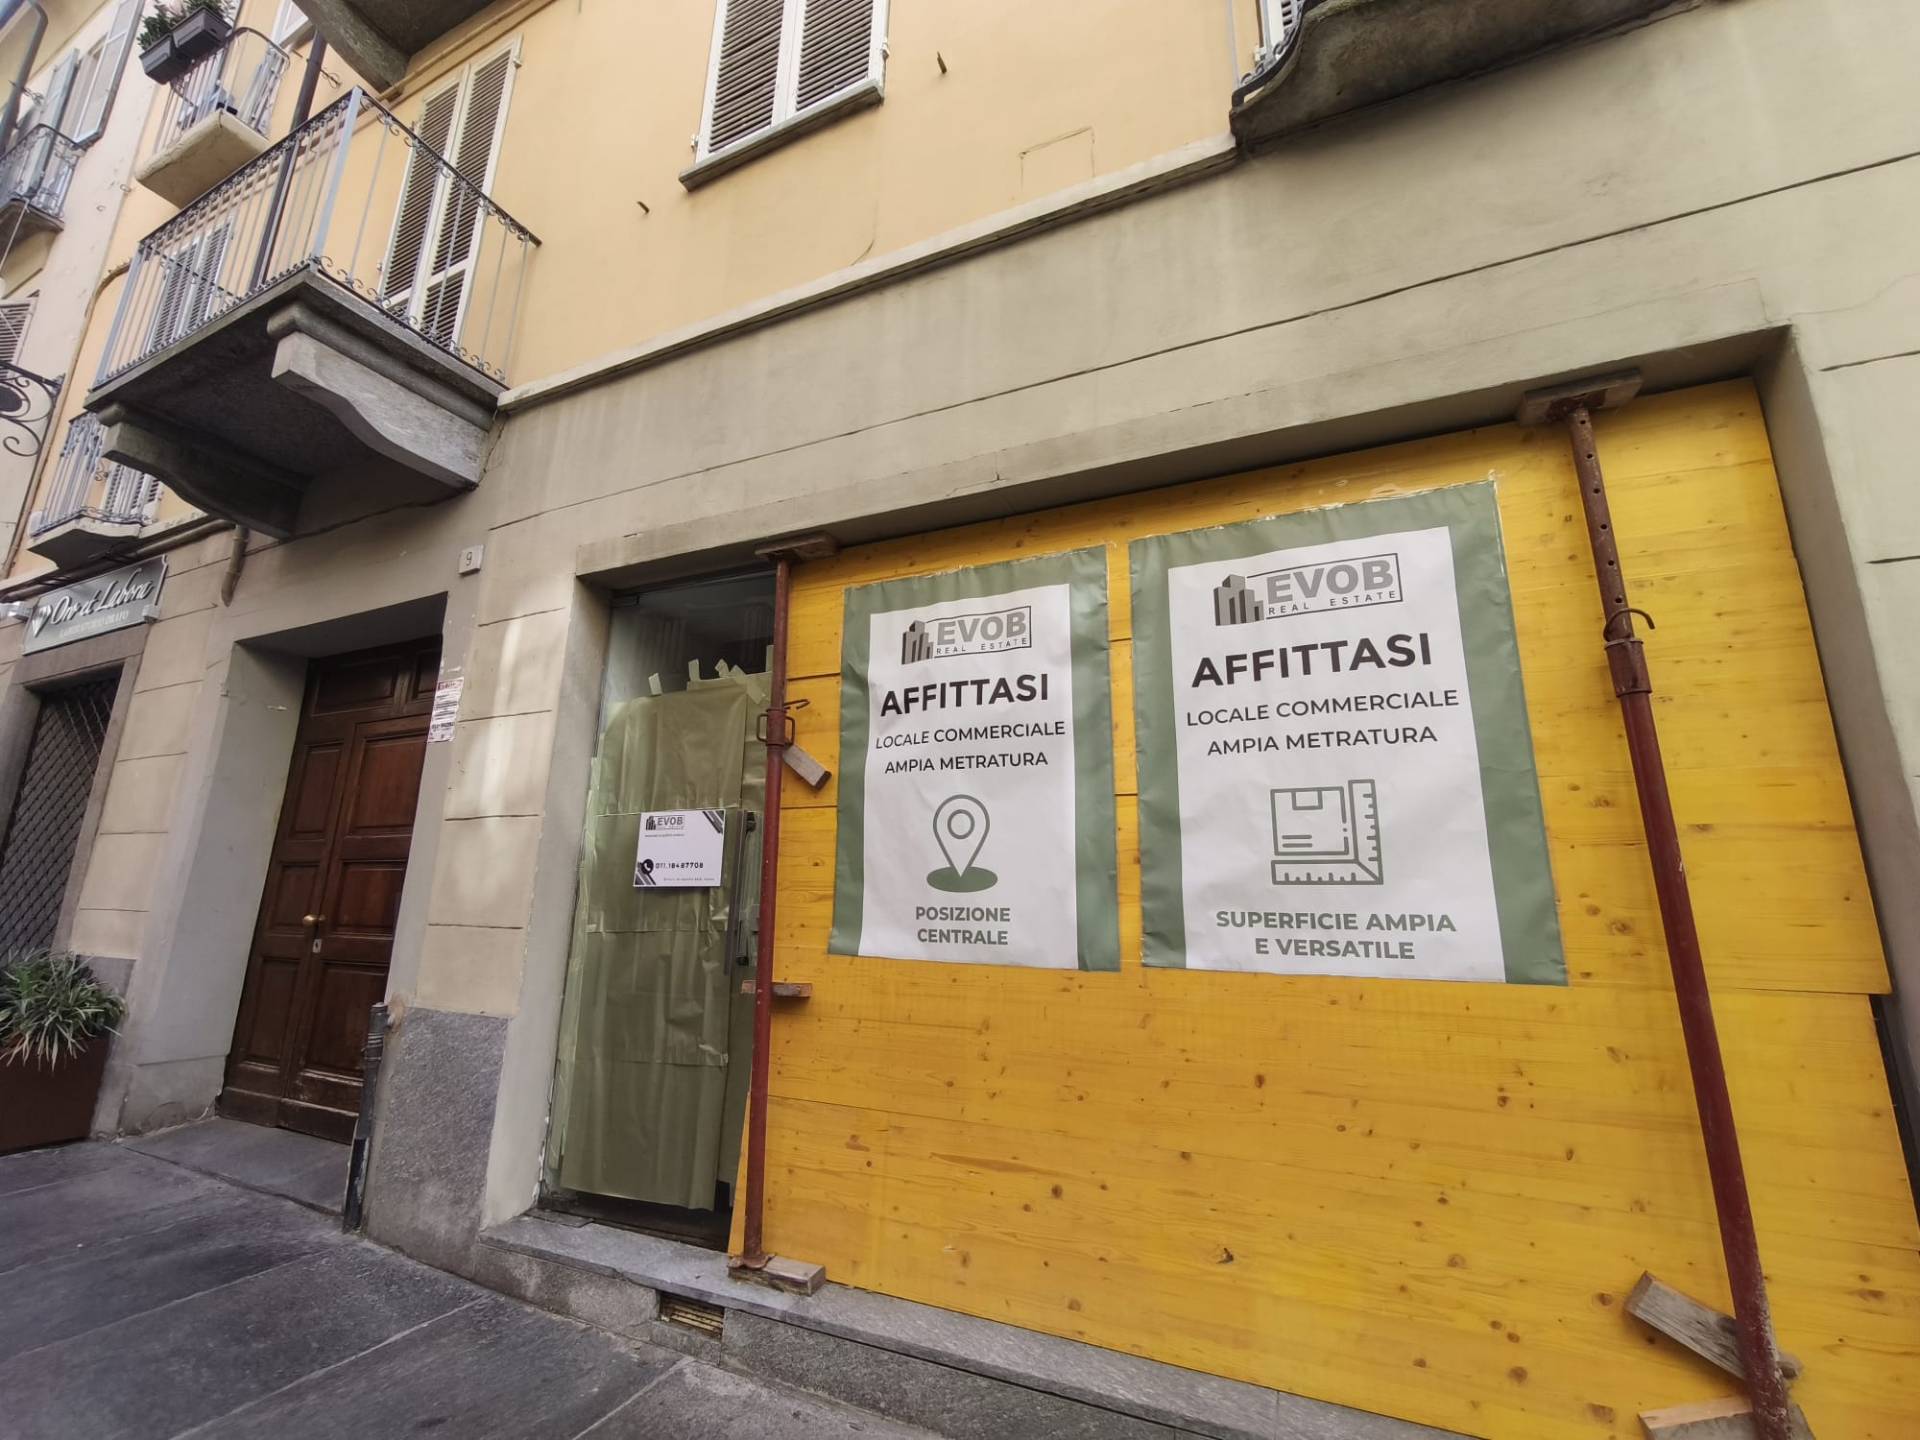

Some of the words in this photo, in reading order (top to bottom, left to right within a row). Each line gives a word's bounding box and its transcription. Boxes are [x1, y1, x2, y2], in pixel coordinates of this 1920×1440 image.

[465, 552, 472, 566] 9
[1266, 559, 1393, 605] EVOB
[1267, 603, 1309, 616] REAL
[1329, 590, 1397, 606] ESTATE
[937, 612, 1026, 645] EVOB
[936, 646, 967, 656] REAL
[980, 637, 1028, 651] ESTATE
[1191, 633, 1433, 688] AFFITTASI
[880, 673, 1049, 717] AFFITTASI
[1186, 704, 1270, 727] LOCALE
[1276, 690, 1459, 718] COMMERCIALE
[875, 731, 929, 749] LOCALE
[933, 721, 1066, 743] COMMERCIALE
[1207, 735, 1280, 757] AMPIA
[1286, 727, 1438, 750] METRATURA
[884, 758, 936, 775] AMPIA
[939, 752, 1049, 771] METRATURA
[657, 817, 683, 826] EVOB
[914, 906, 1012, 923] POSIZIONE
[1216, 910, 1359, 931] SUPERFICIE
[1365, 912, 1457, 933] AMPIA
[916, 928, 1009, 946] CENTRALE
[1254, 938, 1270, 956] E
[1275, 938, 1416, 961] VERSATILE
